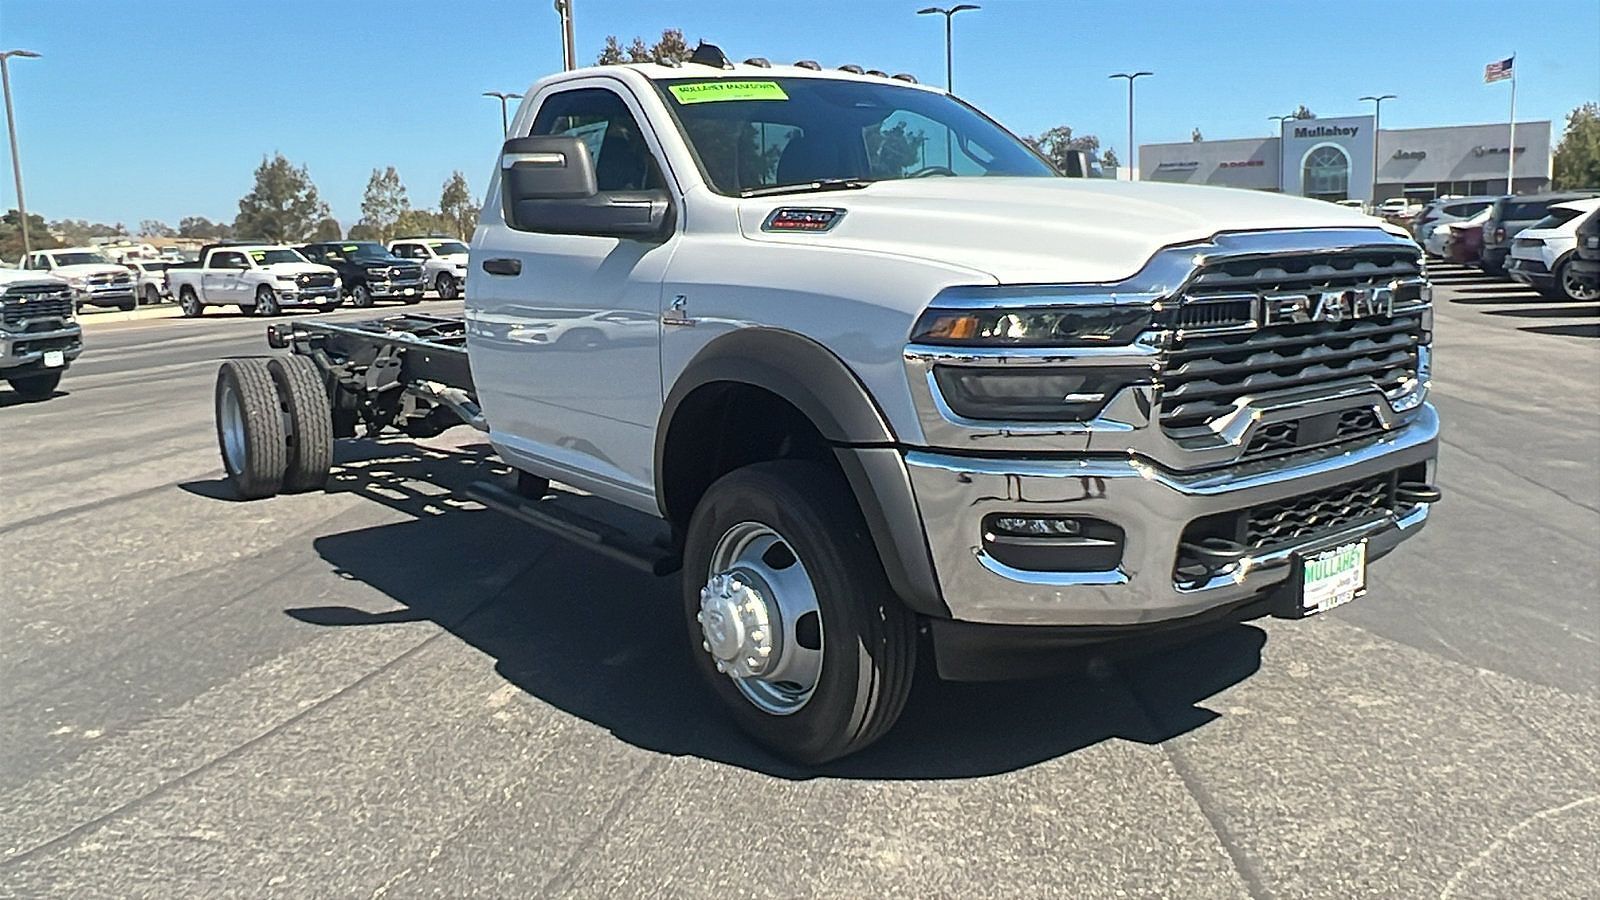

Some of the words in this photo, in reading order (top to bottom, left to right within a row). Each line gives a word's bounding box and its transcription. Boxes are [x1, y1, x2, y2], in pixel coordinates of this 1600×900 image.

[1295, 126, 1359, 138] Mullahey
[1393, 149, 1426, 161] Jeep
[1264, 287, 1395, 326] RAM
[1305, 548, 1361, 584] MULLAHEY
